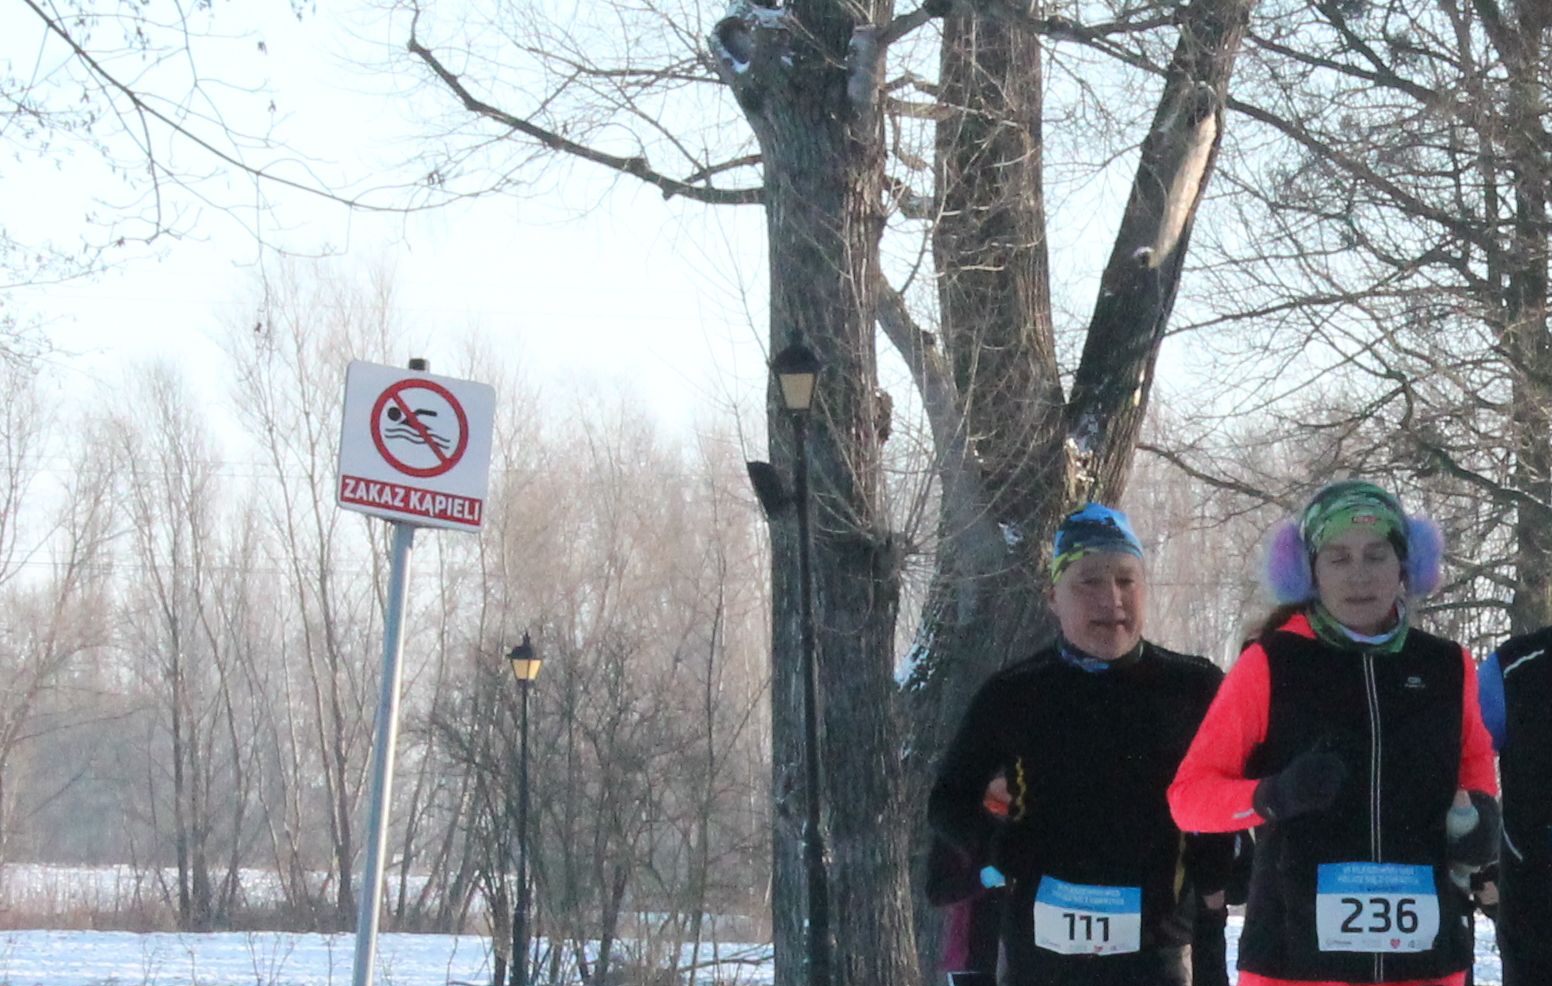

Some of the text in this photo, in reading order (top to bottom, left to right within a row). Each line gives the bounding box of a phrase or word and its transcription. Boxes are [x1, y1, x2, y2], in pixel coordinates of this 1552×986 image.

[343, 478, 480, 522] ZAKAZ KĄPIELI
[1063, 912, 1110, 942] 111
[1340, 897, 1419, 934] 236
